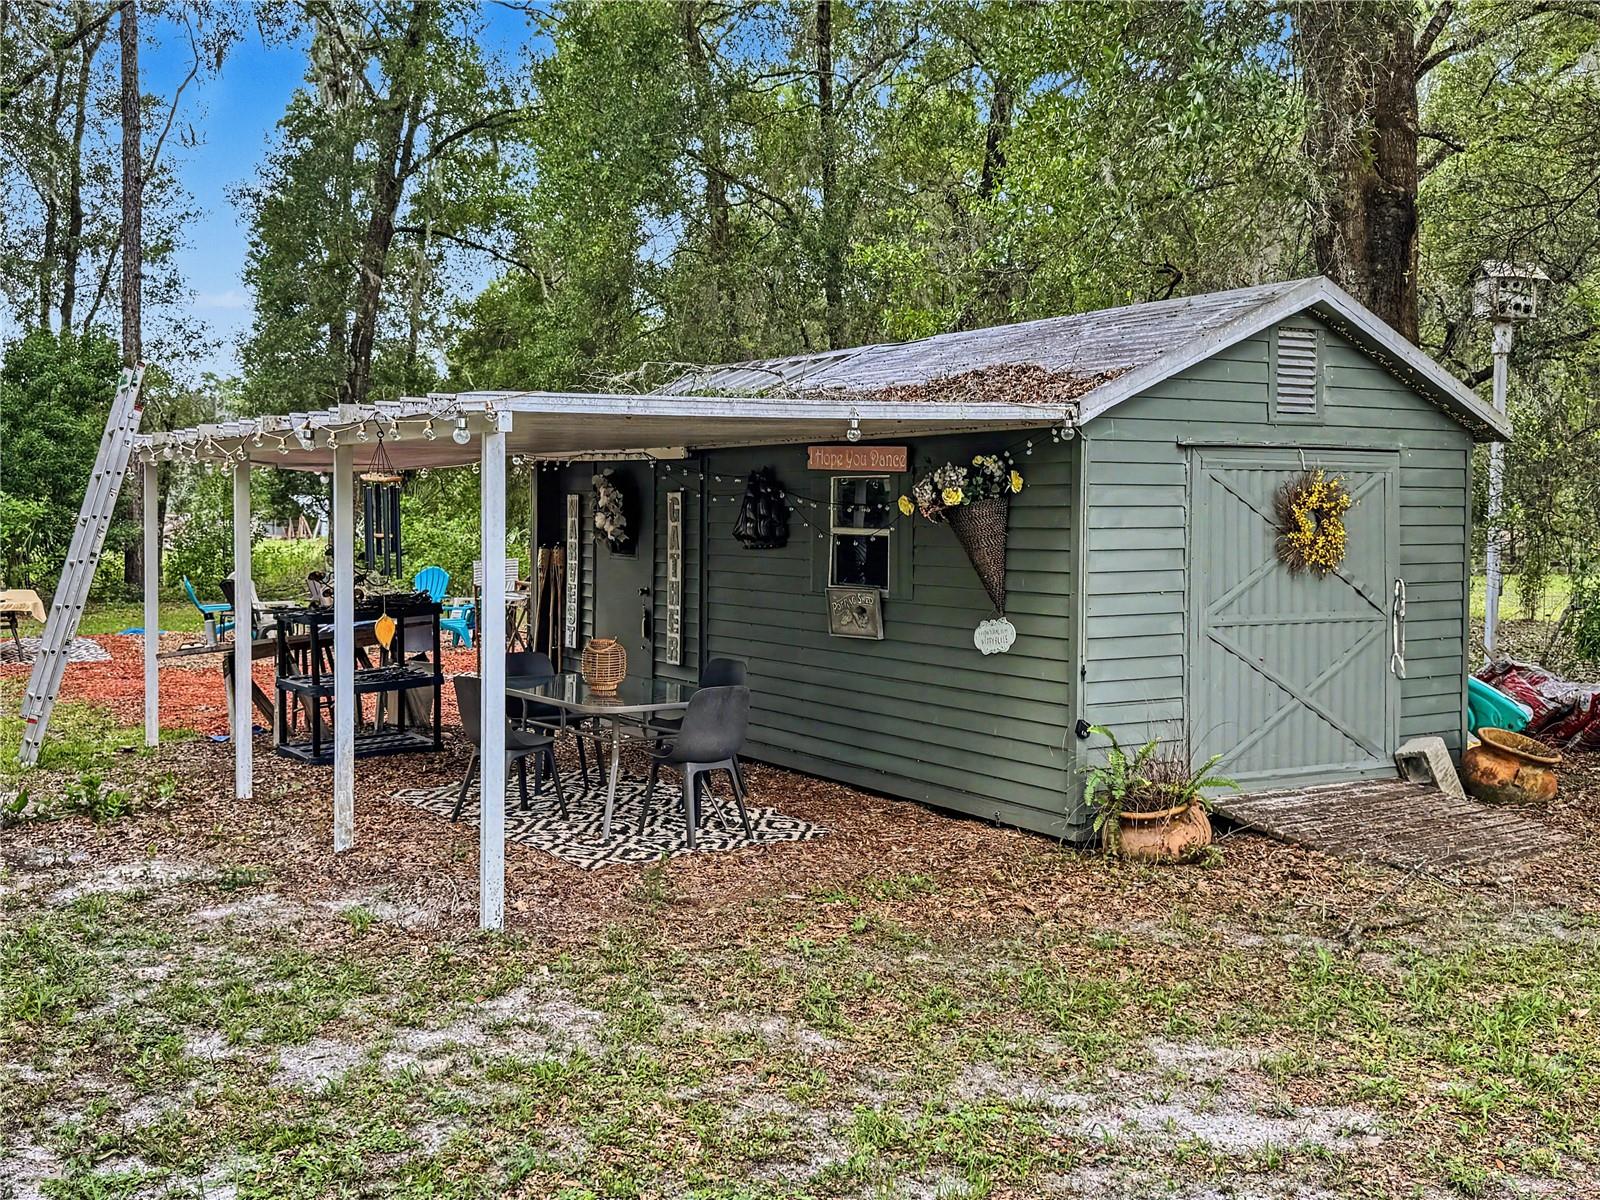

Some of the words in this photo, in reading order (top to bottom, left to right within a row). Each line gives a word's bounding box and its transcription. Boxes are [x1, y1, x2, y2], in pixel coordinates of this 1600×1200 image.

[815, 448, 843, 470] Hope
[846, 449, 868, 469] You
[869, 449, 907, 468] Dance
[668, 496, 681, 662] GATHER
